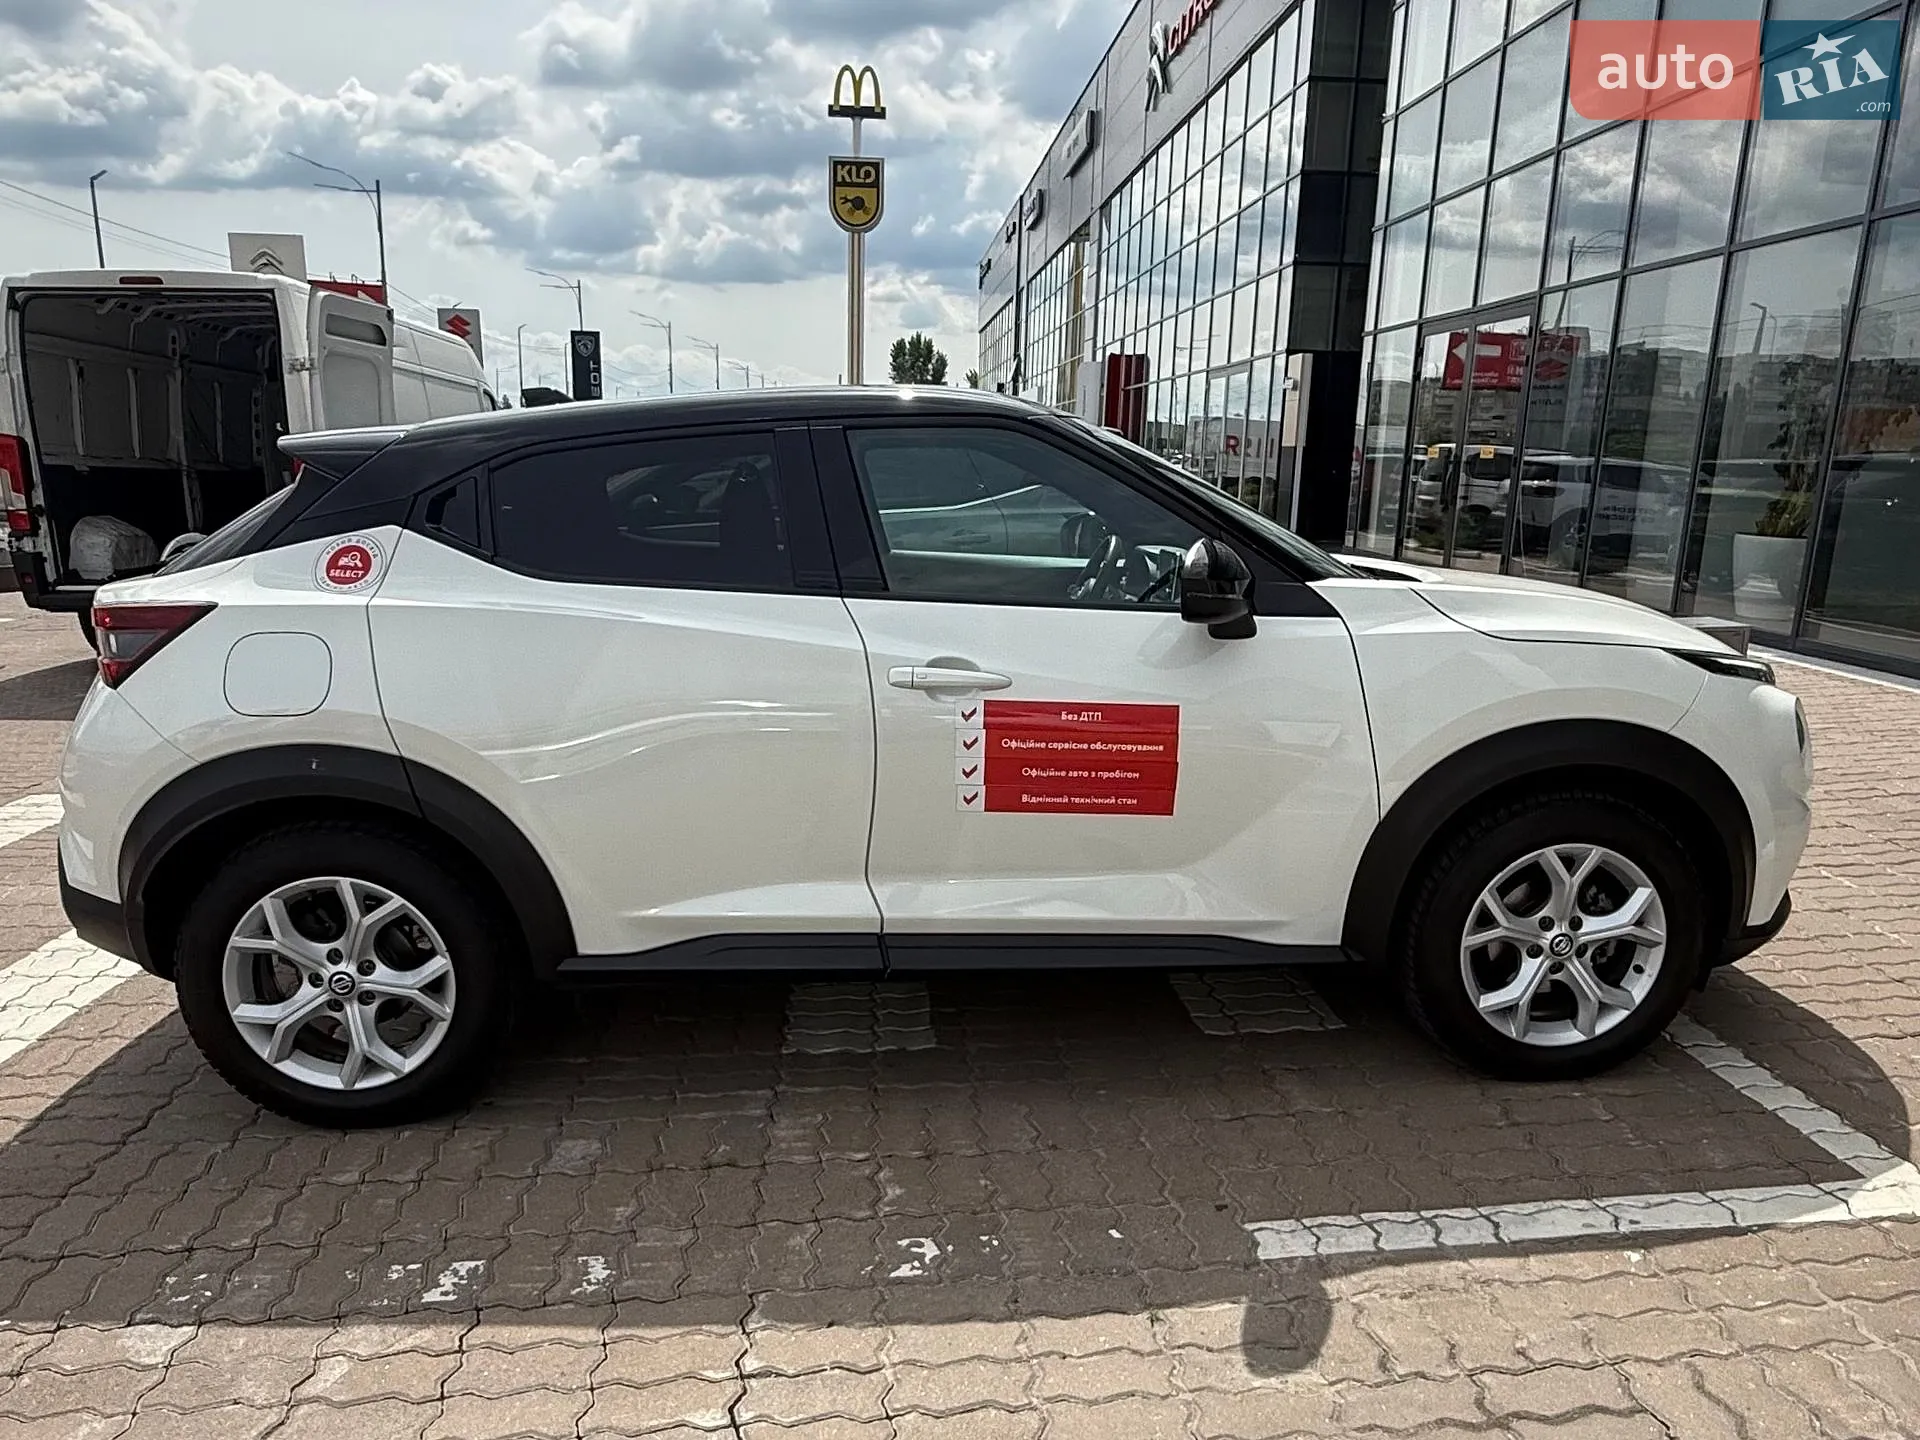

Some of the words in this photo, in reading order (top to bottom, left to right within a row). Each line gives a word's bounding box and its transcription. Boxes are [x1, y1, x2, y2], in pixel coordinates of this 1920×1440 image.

[836, 164, 876, 183] KLO
[329, 568, 365, 578] SELECT
[1061, 711, 1078, 721] Без
[1079, 711, 1102, 722] ДТП
[1001, 738, 1047, 750] Офіційне
[1047, 741, 1088, 751] сервісне
[1090, 741, 1165, 752] обслуговування
[1021, 767, 1067, 779] Офіційне
[1067, 770, 1089, 778] авто
[1097, 769, 1140, 780] пробігом
[1070, 795, 1116, 805] технічний
[1117, 797, 1138, 805] стан
